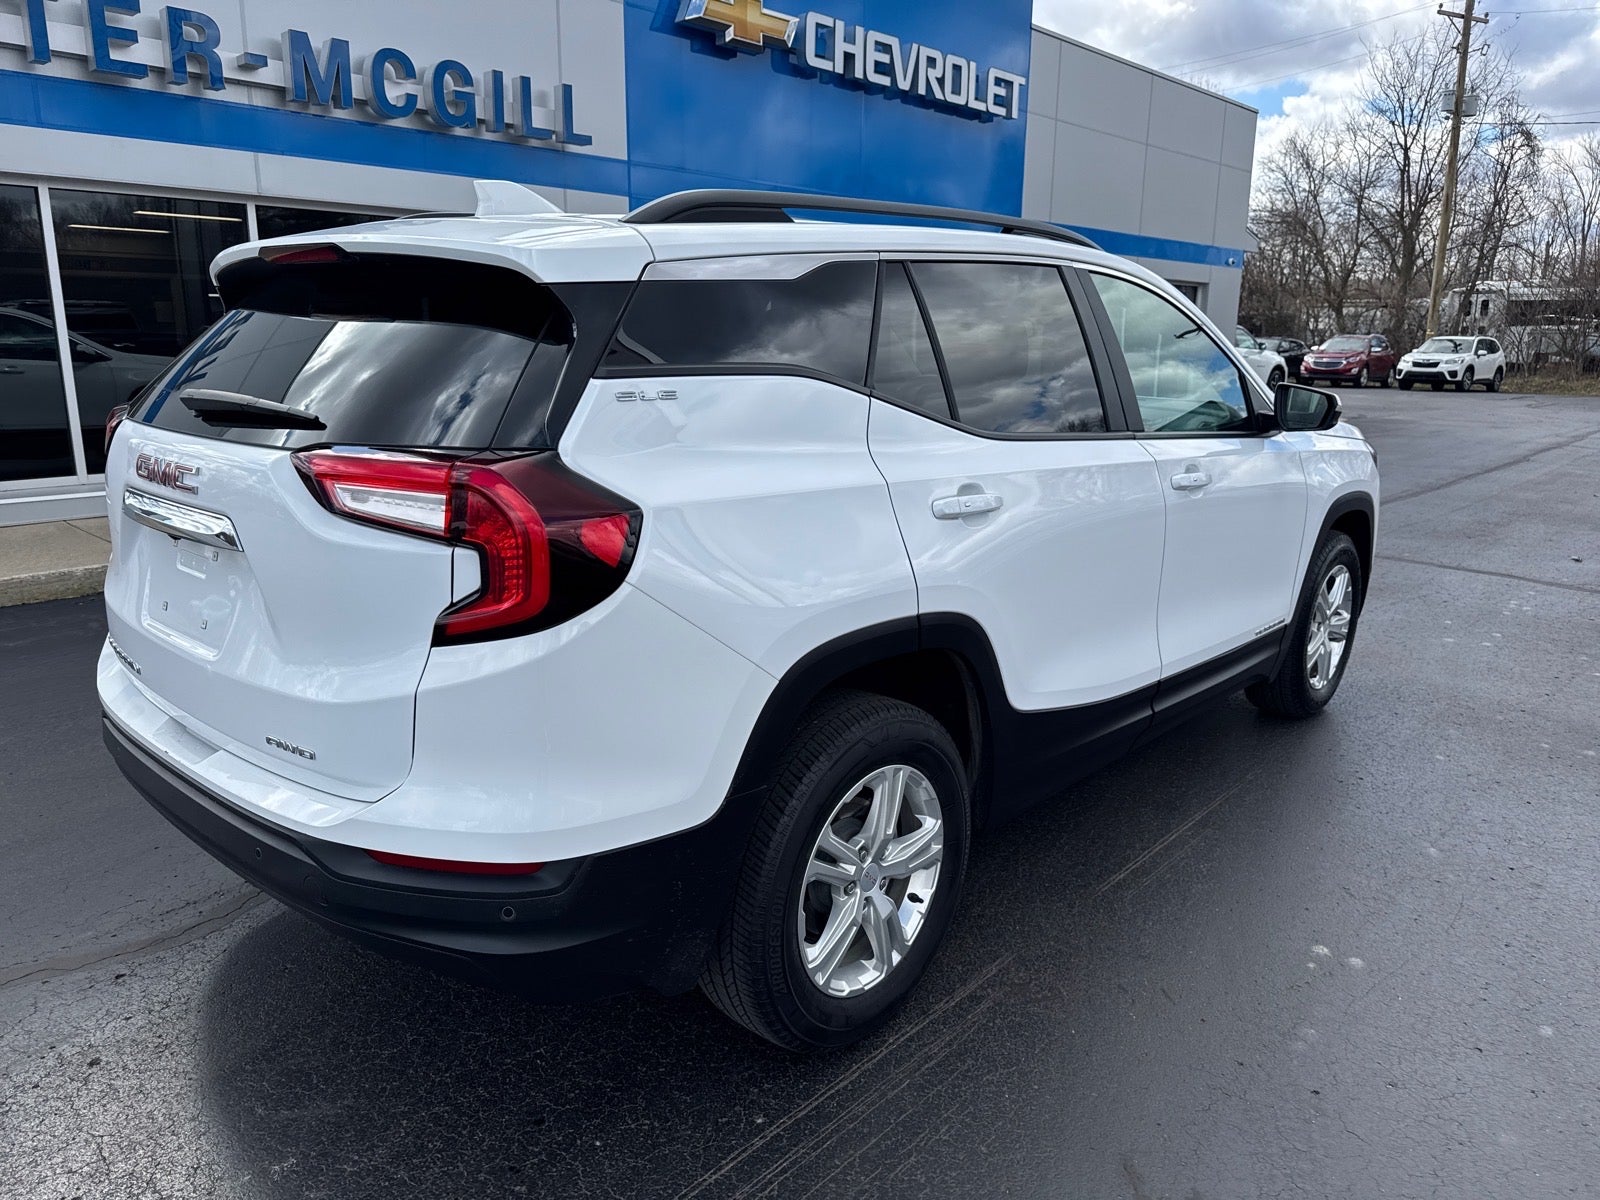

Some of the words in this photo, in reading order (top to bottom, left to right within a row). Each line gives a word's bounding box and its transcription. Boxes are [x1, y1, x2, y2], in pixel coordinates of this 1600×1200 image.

[804, 11, 1026, 119] CHEVROLET
[615, 389, 678, 402] SLE
[136, 453, 200, 495] GMC
[265, 735, 316, 760] AWD
